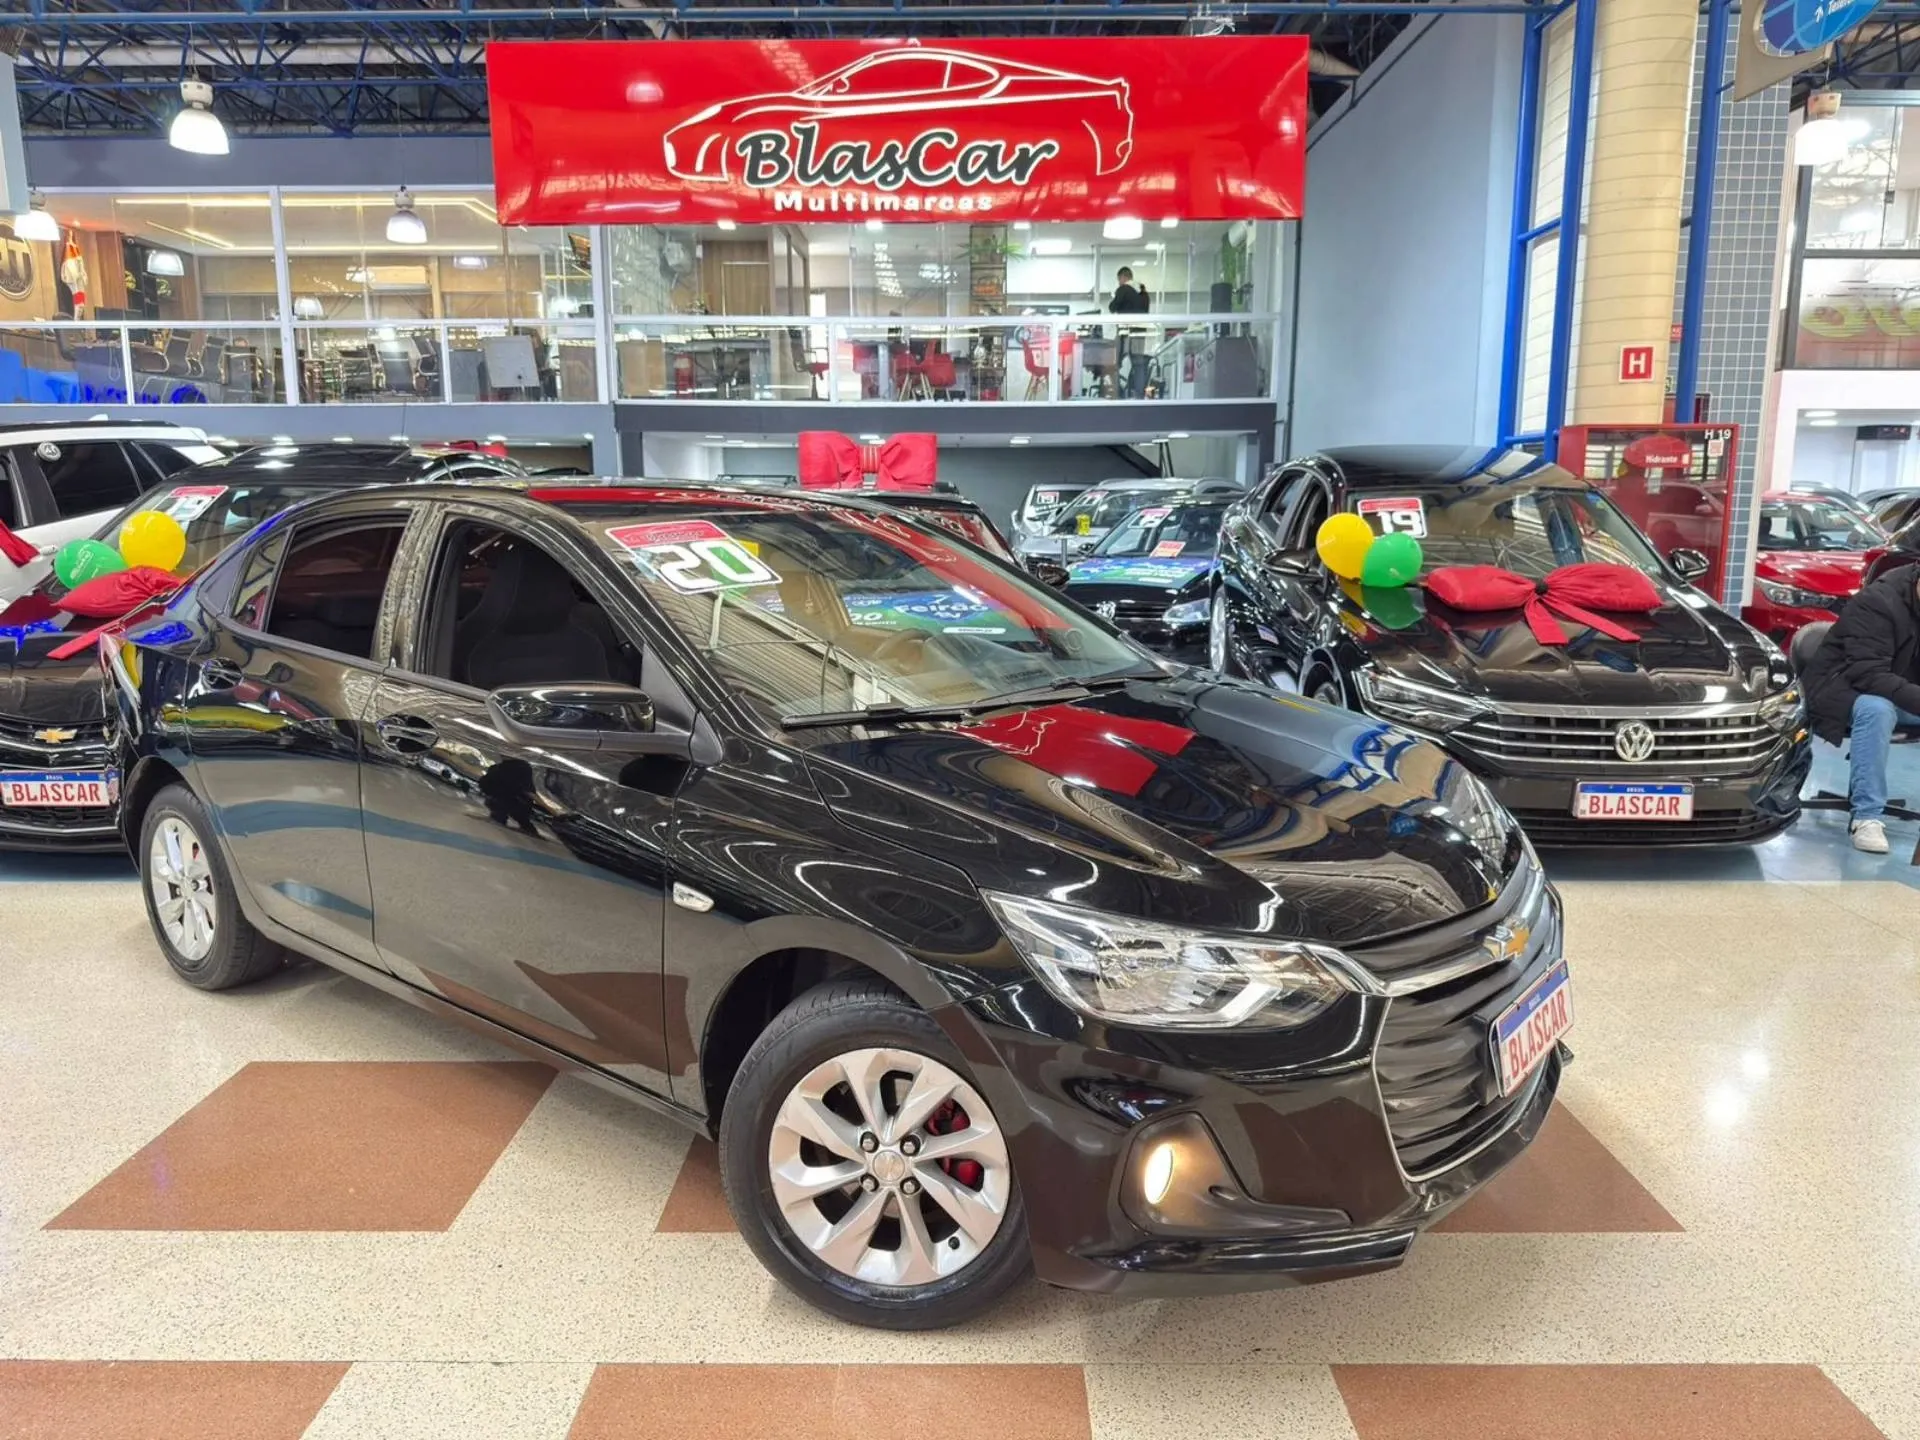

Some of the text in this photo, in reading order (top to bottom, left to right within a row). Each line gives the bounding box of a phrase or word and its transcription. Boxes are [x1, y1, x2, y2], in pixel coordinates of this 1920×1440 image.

[737, 121, 1059, 190] BlasCar
[774, 190, 993, 212] Multimarcas
[1628, 353, 1646, 374] H
[1704, 428, 1732, 440] H 19
[1645, 454, 1678, 464] Hidrante
[1376, 511, 1423, 536] 19
[641, 540, 773, 589] 20
[12, 783, 101, 802] BLASCAR
[1588, 795, 1681, 816] BLASCAR
[1508, 989, 1568, 1080] BLASCAR
